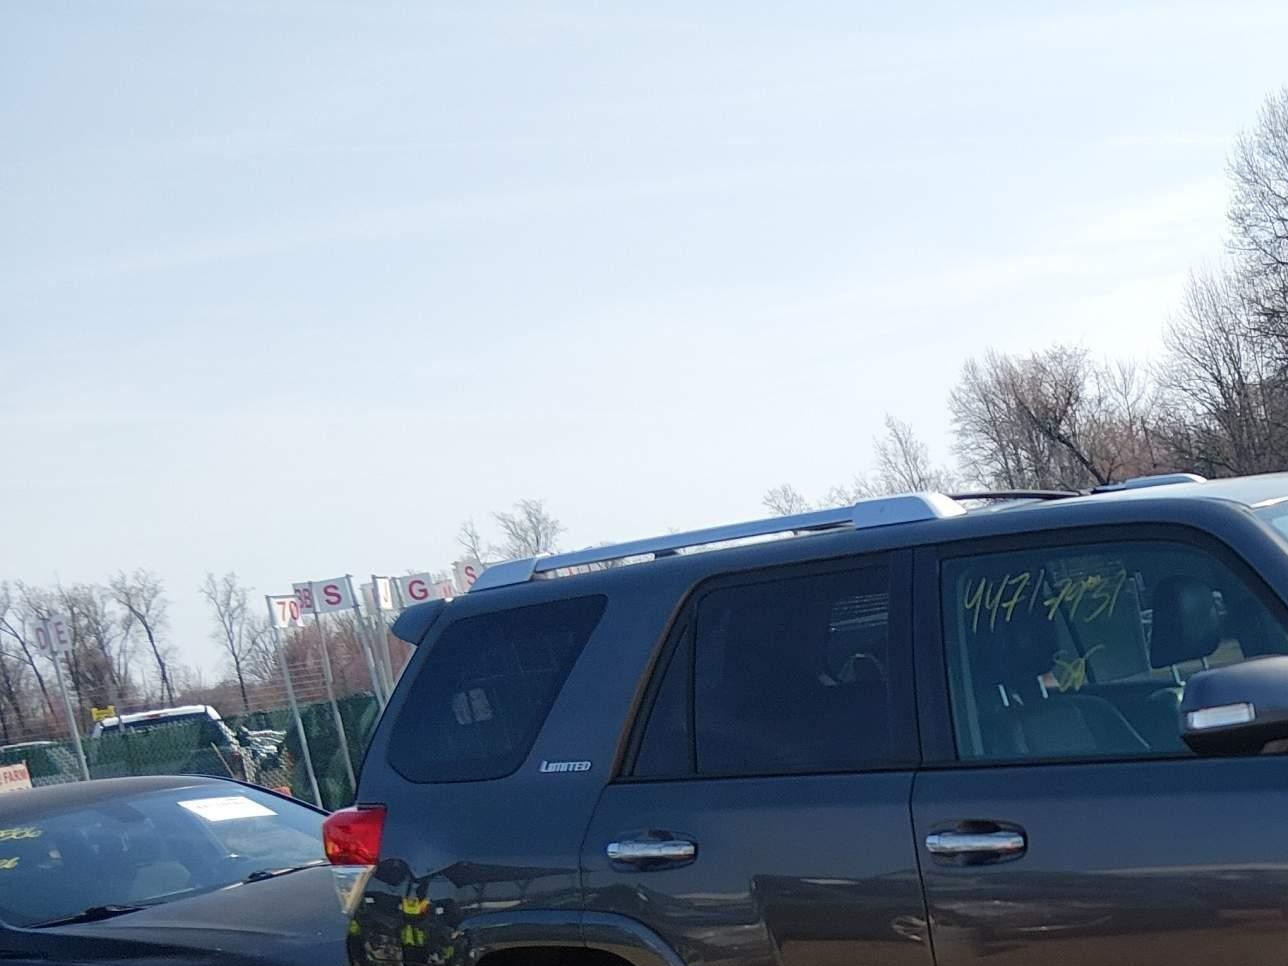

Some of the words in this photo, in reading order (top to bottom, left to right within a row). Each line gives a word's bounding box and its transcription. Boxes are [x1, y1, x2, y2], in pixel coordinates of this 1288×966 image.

[464, 565, 478, 586] S
[323, 579, 343, 605] S
[408, 580, 429, 601] G
[54, 621, 68, 644] E
